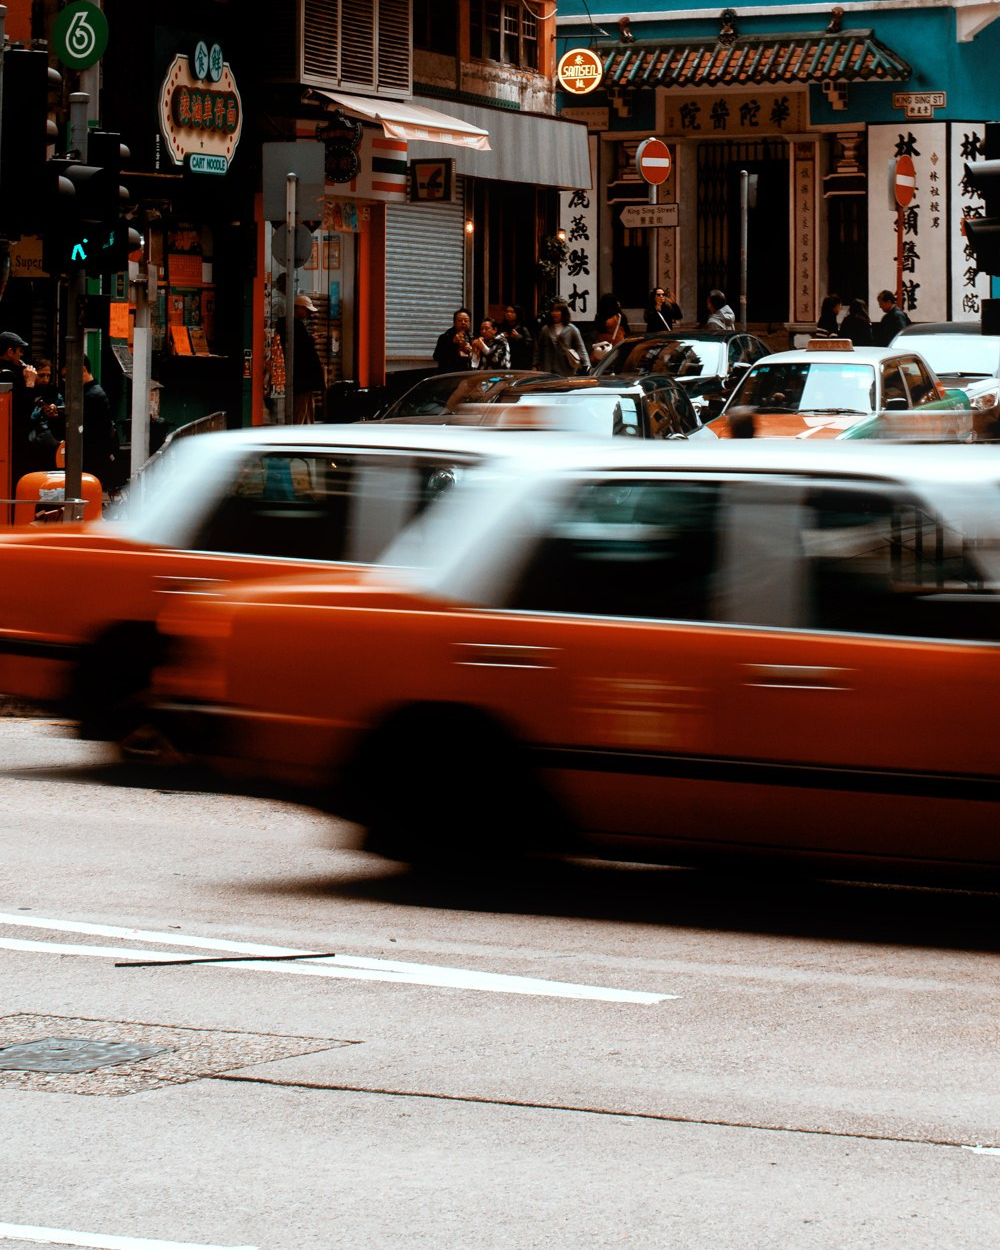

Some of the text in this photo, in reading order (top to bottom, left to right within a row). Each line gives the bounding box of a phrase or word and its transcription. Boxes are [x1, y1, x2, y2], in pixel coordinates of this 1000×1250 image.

[896, 95, 942, 104] KING SING ST
[191, 155, 226, 171] CART NOODLE
[627, 206, 676, 215] King Sing Street
[16, 255, 42, 270] Super
